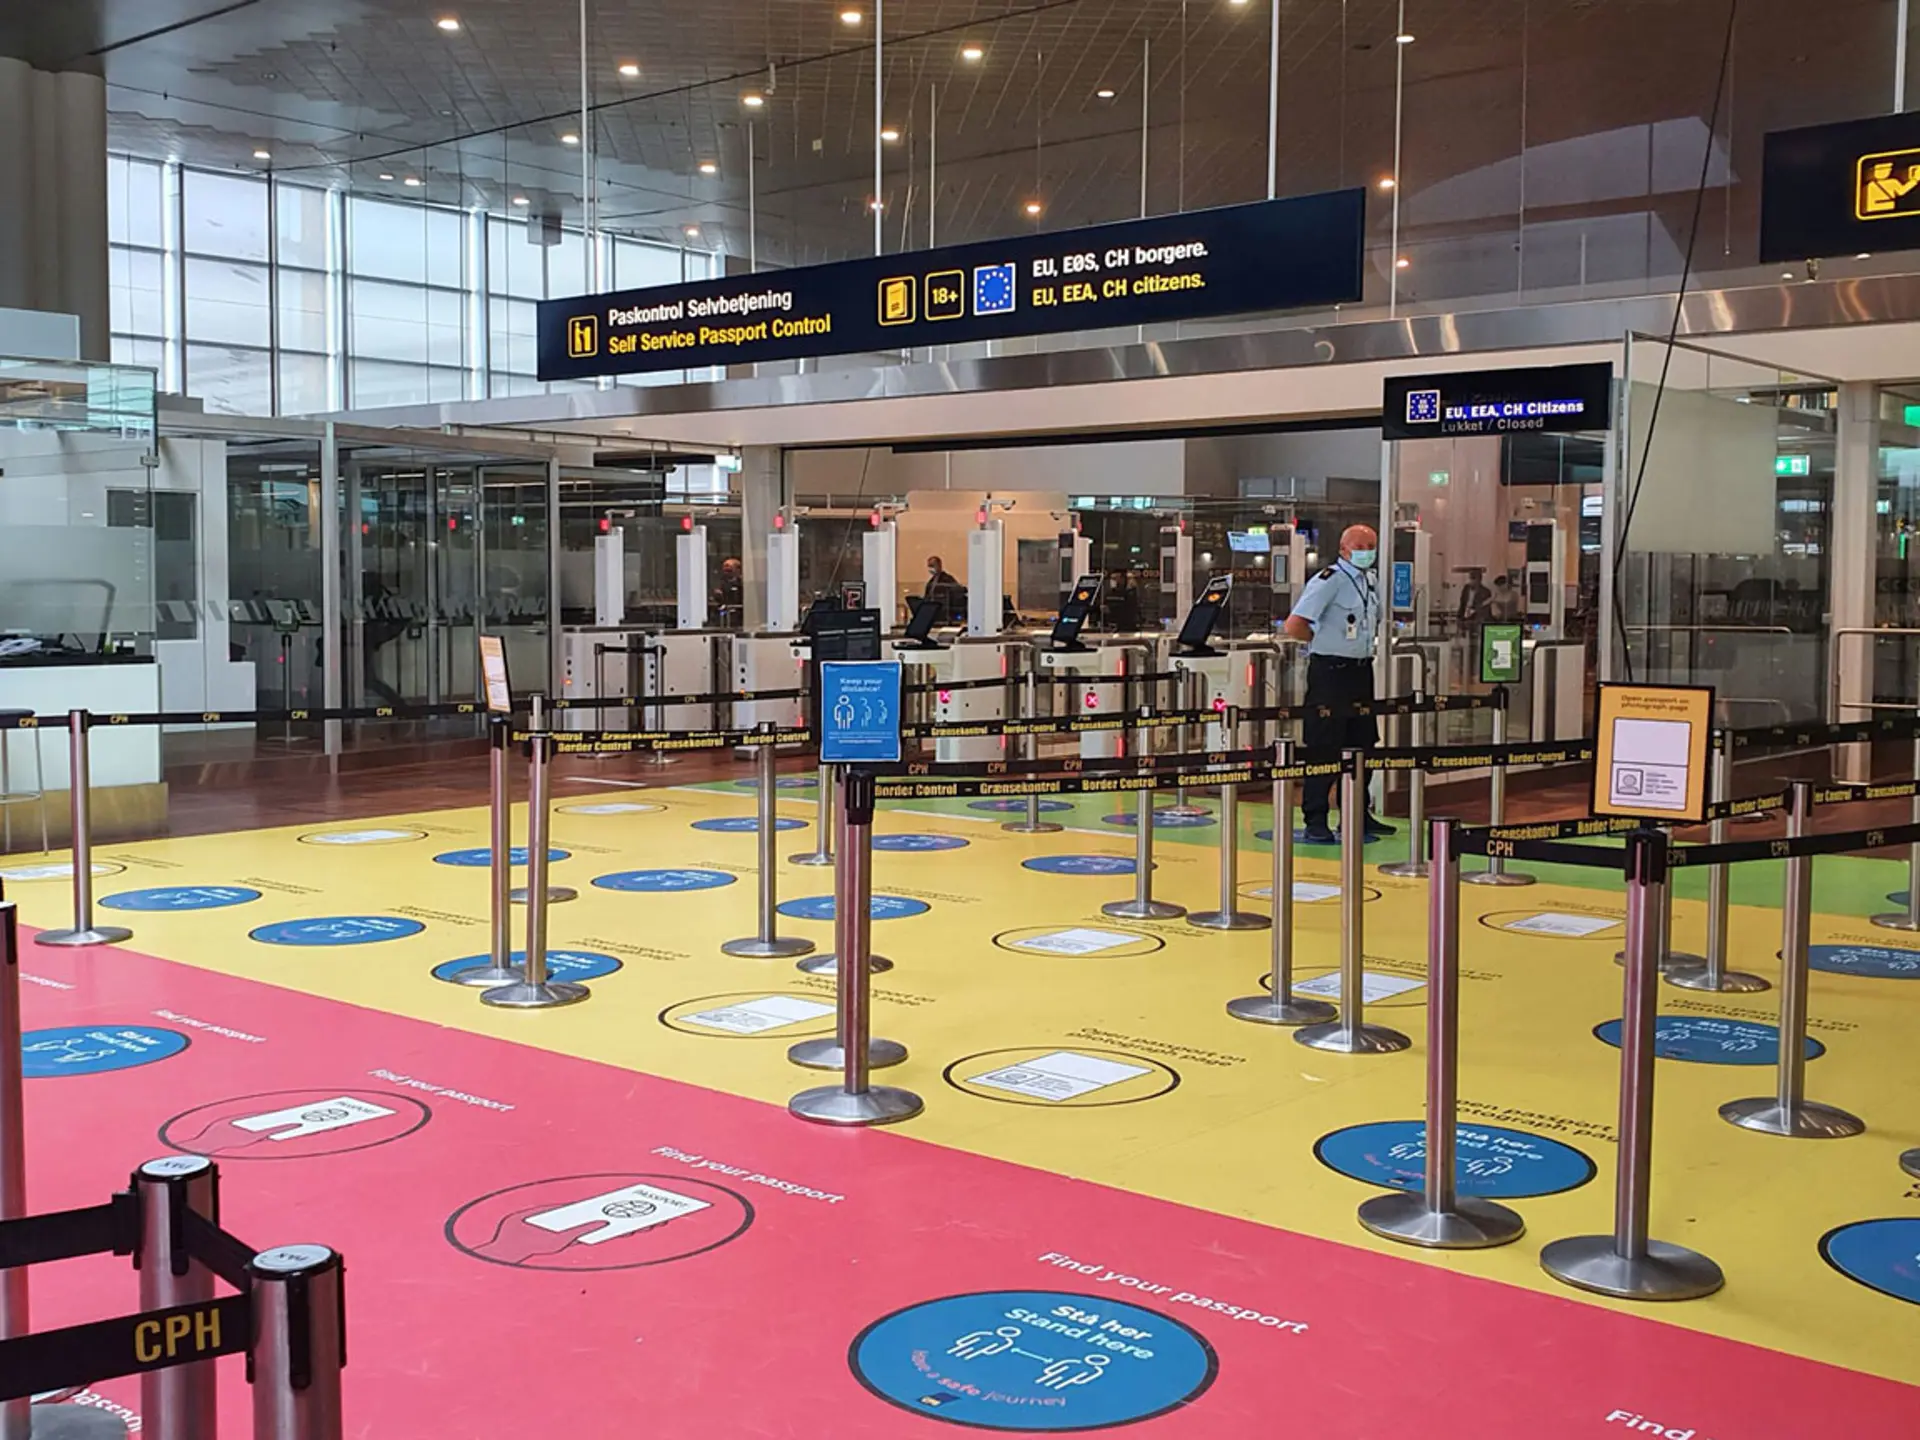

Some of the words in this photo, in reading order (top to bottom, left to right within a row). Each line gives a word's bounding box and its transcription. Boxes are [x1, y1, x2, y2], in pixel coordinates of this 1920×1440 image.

[1032, 259, 1058, 278] EU,
[1063, 254, 1099, 274] EØS,
[1105, 248, 1130, 268] CH
[1135, 241, 1208, 266] borgere.
[932, 286, 958, 305] 18+
[1032, 288, 1058, 307] EU,
[1063, 284, 1097, 303] EEA,
[1103, 279, 1127, 298] CH
[1133, 272, 1206, 294] citizens.
[608, 302, 683, 327] Paskontrol
[687, 290, 792, 316] Selvbetjening
[609, 336, 638, 354] Self
[641, 330, 695, 352] Service
[699, 322, 767, 347] Passport
[772, 313, 831, 338] Control
[1442, 420, 1483, 433] Lukket
[1497, 417, 1544, 430] Closed
[1445, 407, 1467, 420] EU,
[1471, 405, 1500, 418] EEA,
[1503, 403, 1522, 415] CH
[1527, 401, 1584, 414] Citizens
[1486, 840, 1514, 857] CPH
[1503, 1107, 1614, 1132] passport
[651, 1146, 703, 1164] Find
[691, 1160, 750, 1177] your
[742, 1173, 845, 1204] passport
[1038, 1251, 1104, 1275] Find
[1096, 1270, 1173, 1295] your
[1168, 1291, 1309, 1335] passport
[135, 1308, 222, 1364] CPH
[1100, 1319, 1153, 1340] her
[1087, 1332, 1154, 1360] here
[1604, 1409, 1697, 1440] Find
